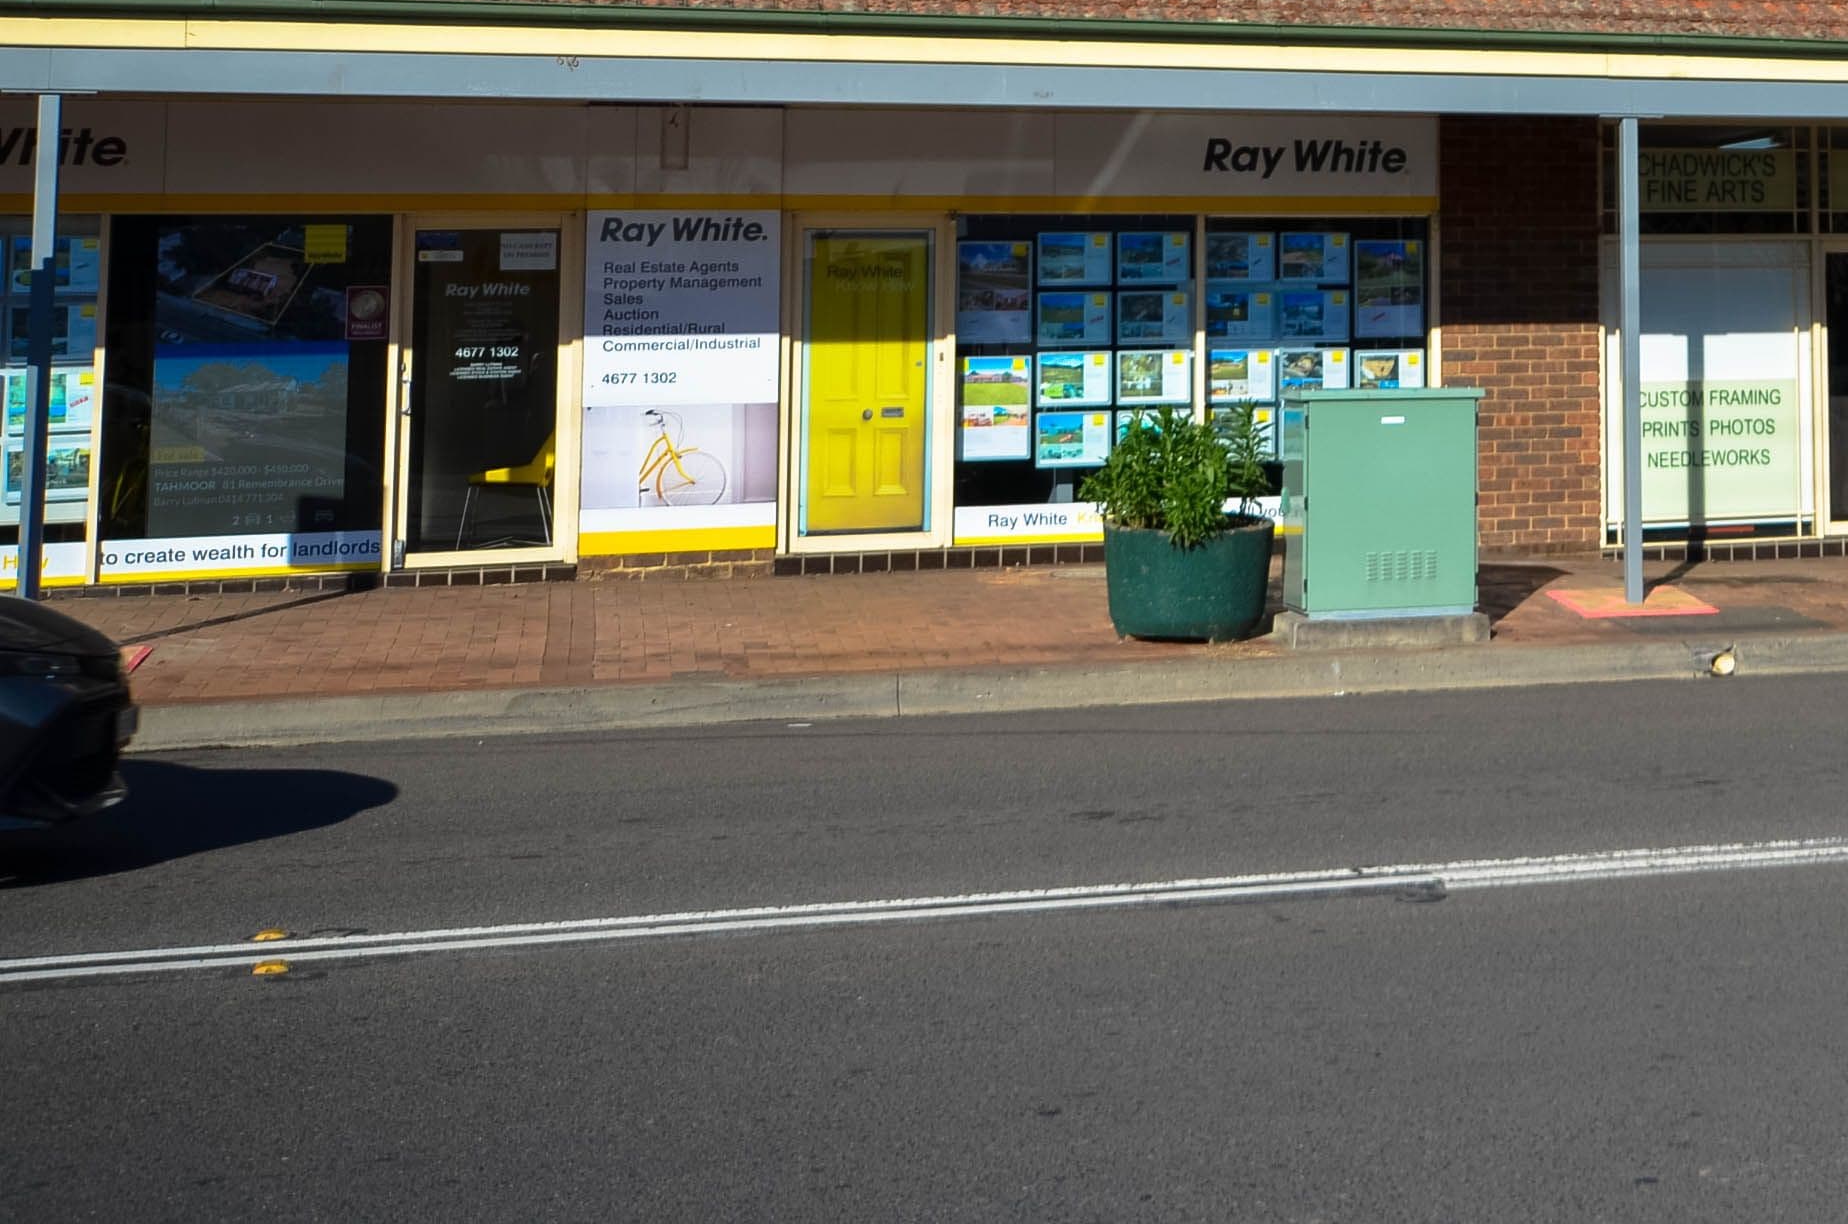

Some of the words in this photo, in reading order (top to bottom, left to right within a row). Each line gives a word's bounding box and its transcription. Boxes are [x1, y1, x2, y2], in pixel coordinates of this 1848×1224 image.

[1204, 138, 1285, 179] Ray
[1294, 139, 1407, 173] White
[1647, 179, 1697, 202] FINE
[1706, 179, 1765, 202] ARTS
[600, 217, 666, 247] Ray
[604, 261, 635, 273] Real
[641, 261, 685, 273] Estate
[689, 261, 739, 275] Agents
[826, 264, 857, 281] Ray
[862, 263, 904, 279] White
[445, 283, 480, 299] Ray
[482, 282, 530, 296] White
[603, 277, 665, 291] Property
[670, 276, 762, 290] Management
[603, 293, 643, 305] Sales
[603, 309, 659, 321] Auction
[603, 322, 725, 336] Residential/Rural
[455, 347, 485, 358] 4677
[490, 346, 519, 357] 1302
[603, 337, 761, 352] Commercial/Industrial
[602, 373, 637, 384] 4677
[644, 372, 677, 384] 1302
[1639, 390, 1704, 408] CUSTOM
[1709, 389, 1781, 406] FRAMING
[1642, 420, 1700, 437] PRINTS
[1710, 418, 1775, 435] PHOTOS
[1648, 448, 1771, 468] NEEDLEWORKS
[988, 514, 1018, 531] Ray
[1024, 512, 1067, 526] White
[100, 550, 118, 566] to
[125, 548, 186, 564] create
[193, 544, 254, 562] wealth
[260, 544, 287, 559] for
[292, 539, 381, 557] landlords
